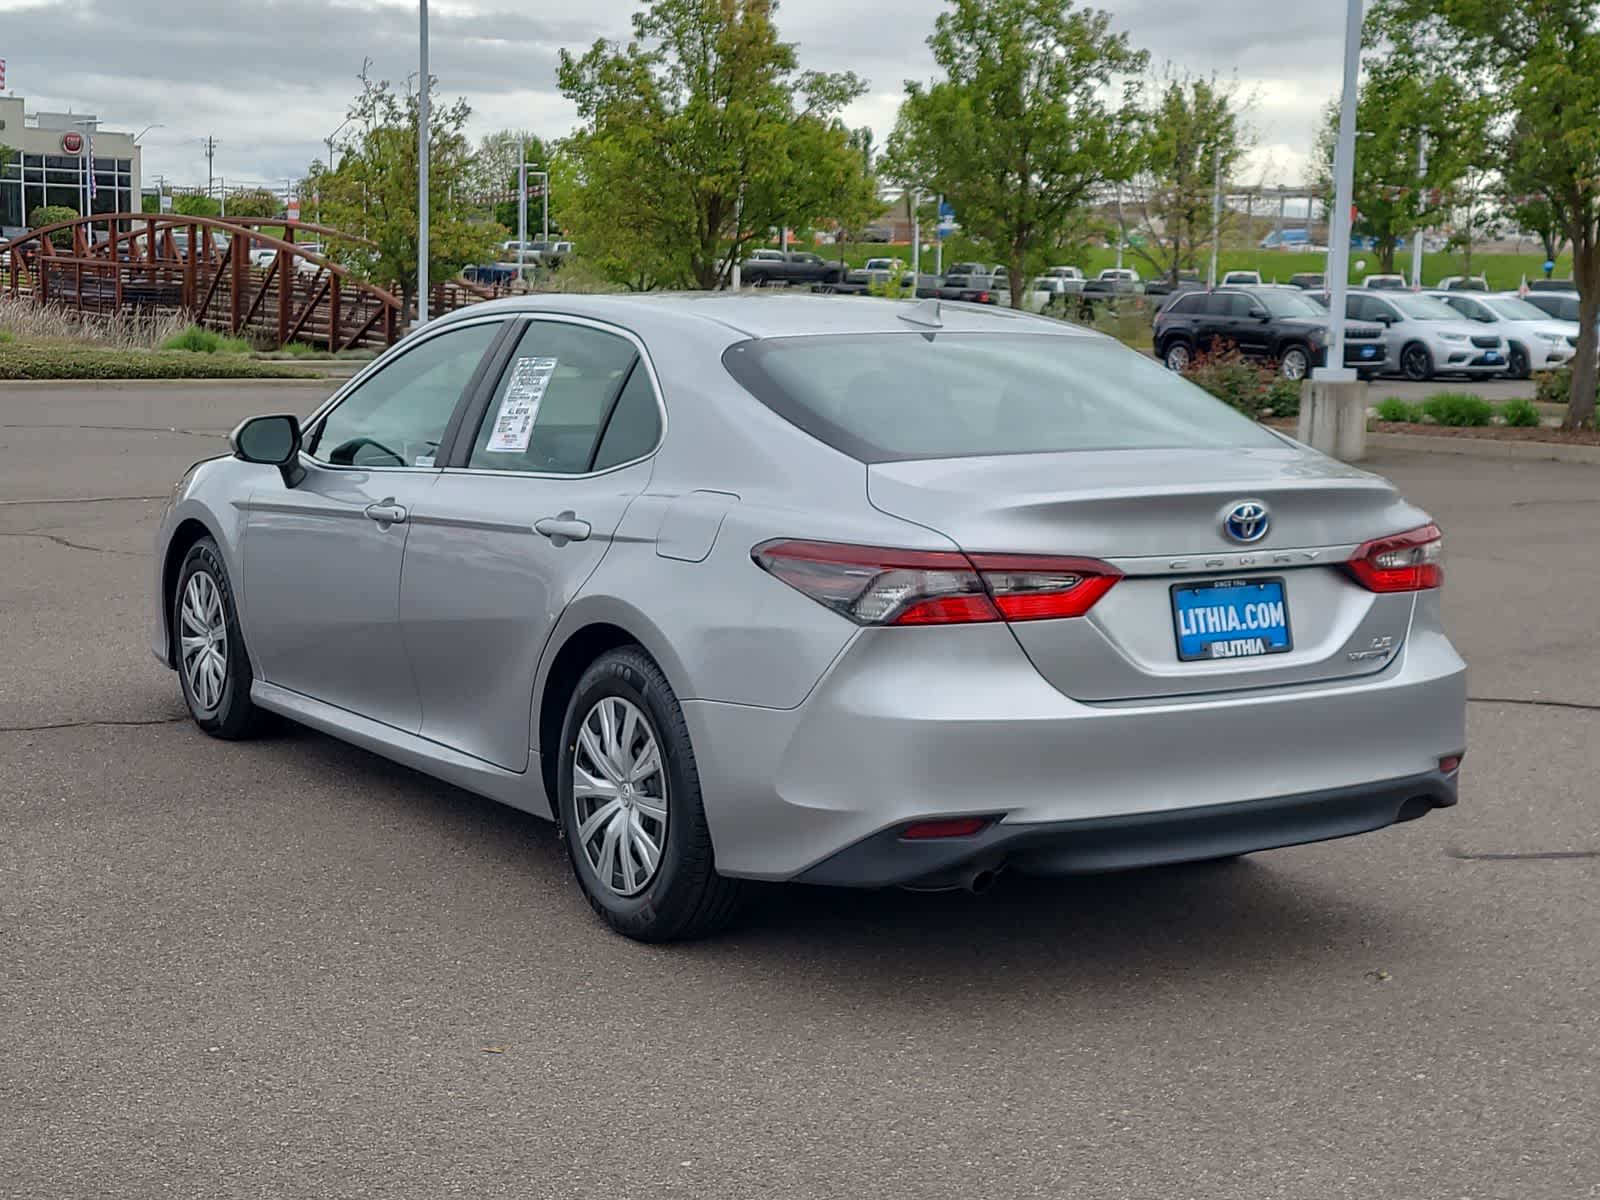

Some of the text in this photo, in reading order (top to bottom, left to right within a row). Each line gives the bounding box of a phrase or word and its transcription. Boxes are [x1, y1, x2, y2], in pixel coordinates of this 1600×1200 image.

[1168, 551, 1321, 570] CAMRY
[1179, 601, 1286, 636] LITHIA.COM
[1225, 638, 1266, 656] LITHIA
